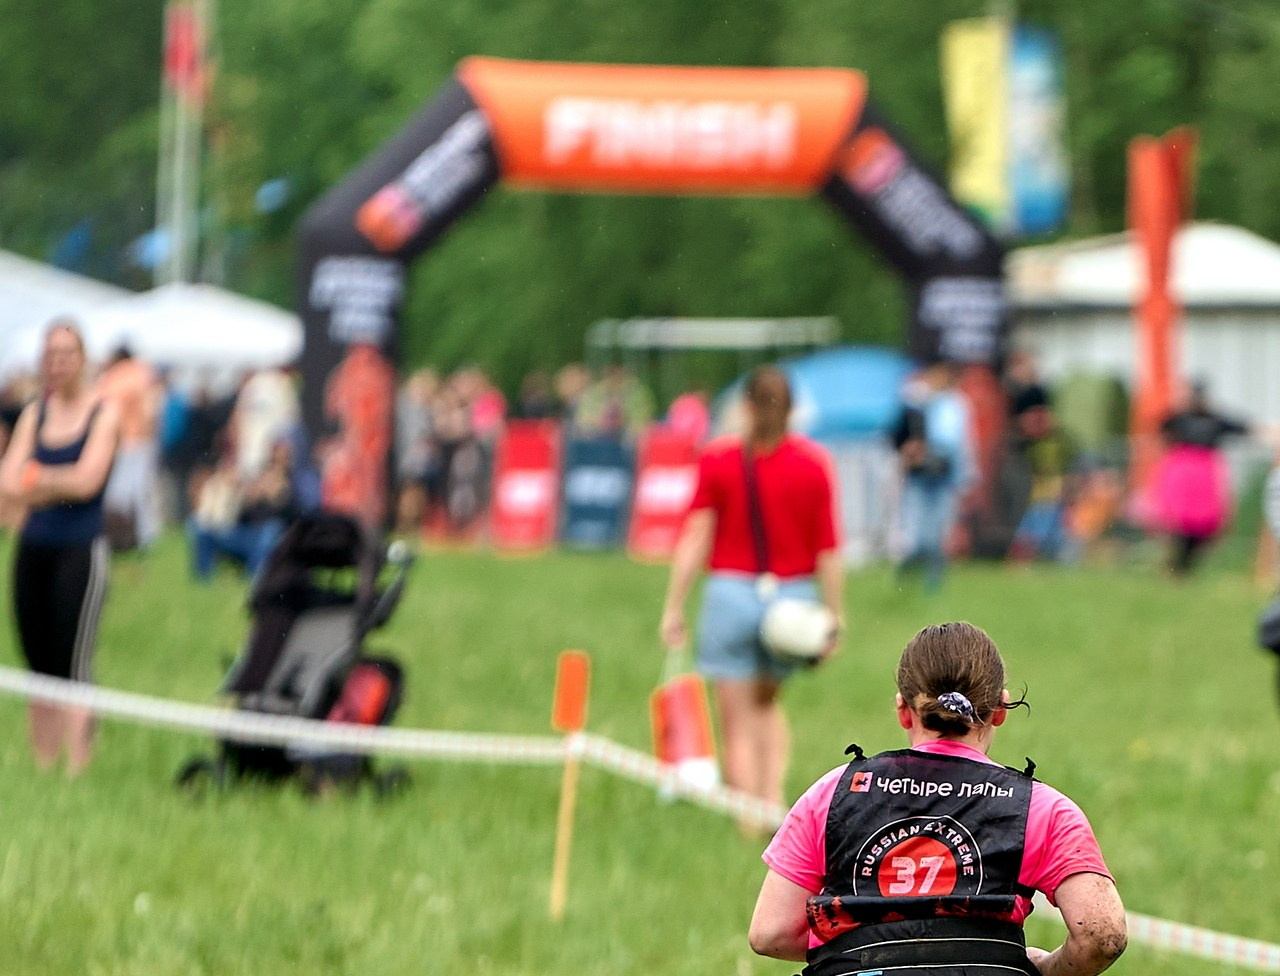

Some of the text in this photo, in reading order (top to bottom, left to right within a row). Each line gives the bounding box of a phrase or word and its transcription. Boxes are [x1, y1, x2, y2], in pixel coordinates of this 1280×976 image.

[544, 99, 797, 169] FINISH
[861, 821, 974, 877] RUSSIAN EXTREME
[889, 856, 945, 894] 37
